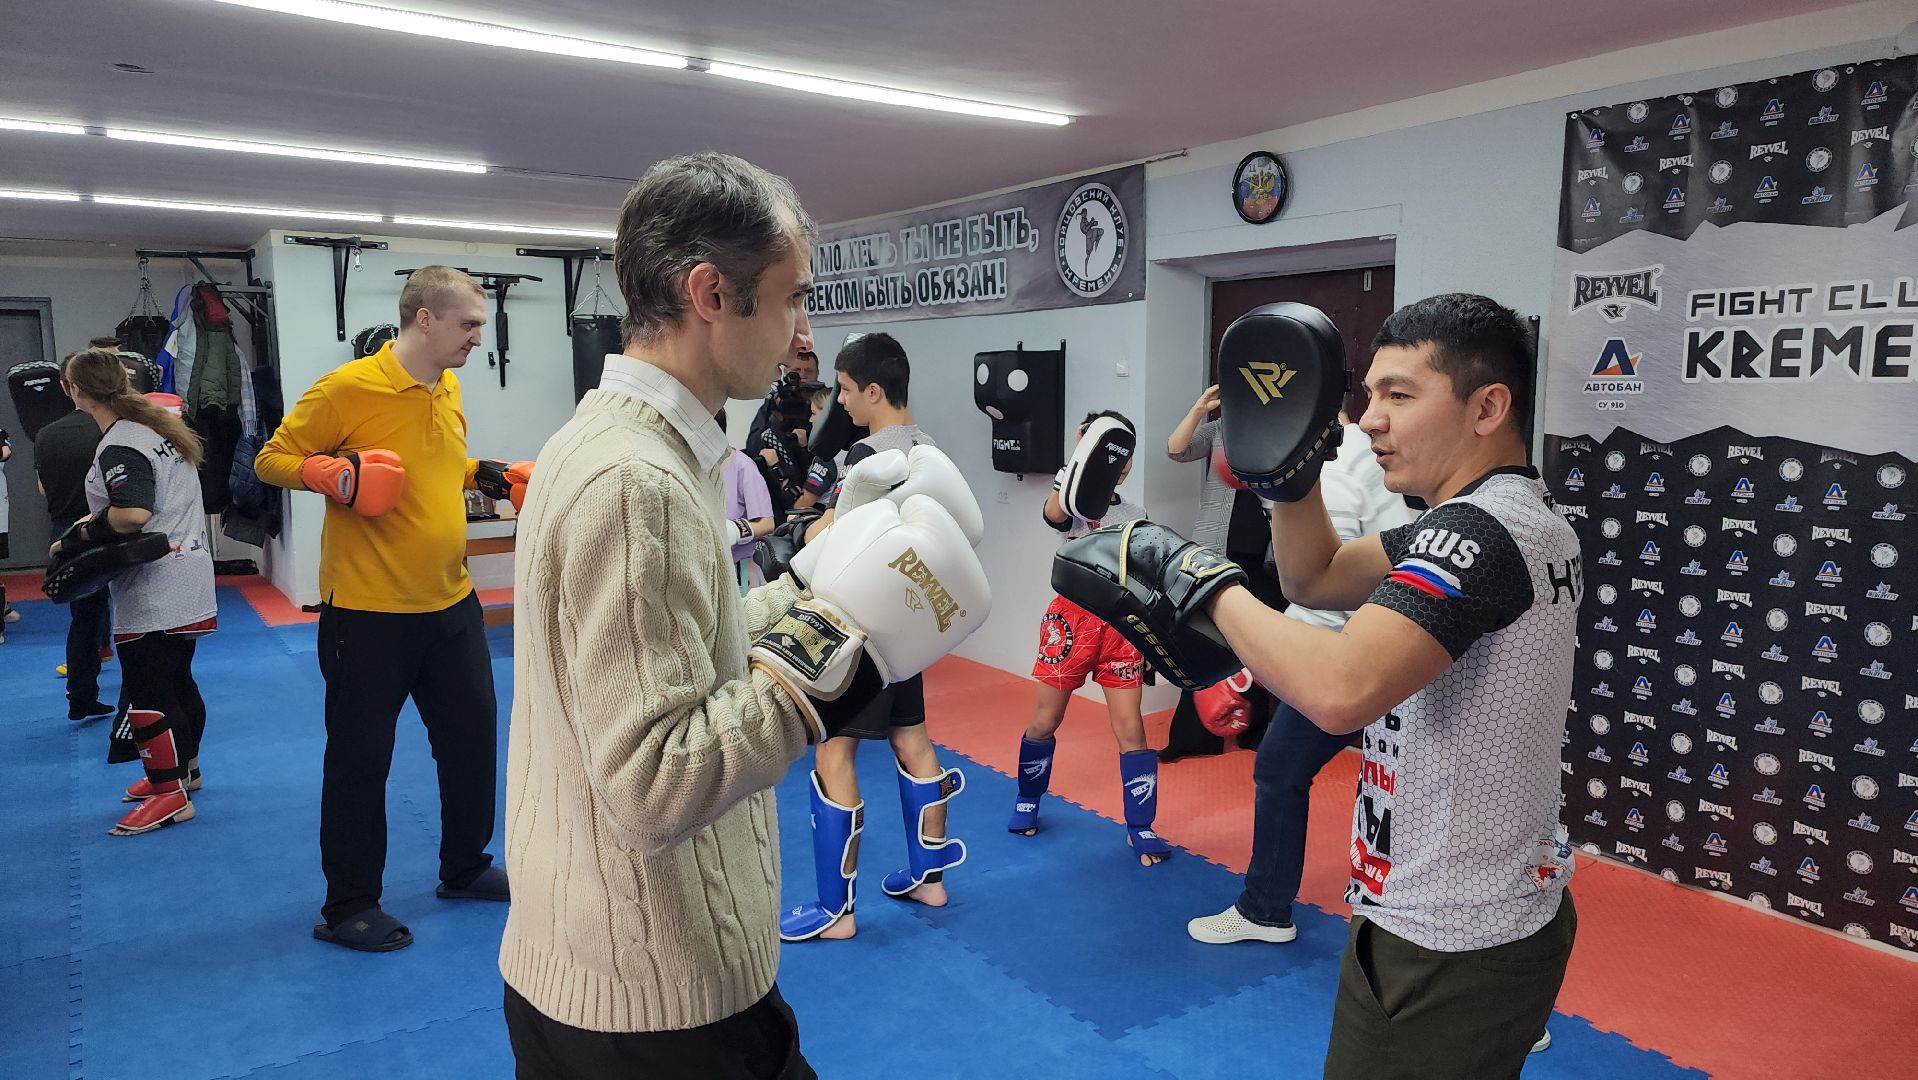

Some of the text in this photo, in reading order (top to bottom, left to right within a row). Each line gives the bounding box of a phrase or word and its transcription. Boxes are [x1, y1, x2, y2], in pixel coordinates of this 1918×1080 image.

[1850, 126, 1890, 146] REYVEL
[1749, 141, 1788, 160] REYVEL
[1659, 155, 1694, 172] REYVEL
[1578, 166, 1608, 183] REYVEL
[900, 225, 929, 264] ТЫ
[934, 220, 963, 260] НЕ
[967, 206, 1039, 256] БЫТЬ,
[805, 258, 1008, 315] ВЕКОМ БЫТЬ ОБЯЗАН!
[1063, 263, 1120, 292] КРЕМЕНЬ
[1572, 269, 1659, 311] REYVEL
[1690, 287, 1813, 318] FIGHT
[1583, 382, 1642, 392] АВТОБАН
[1598, 401, 1625, 409] СУ 910
[1726, 445, 1764, 461] REYVEL
[812, 462, 829, 477] RUS
[1635, 510, 1669, 527] REYVEL
[1722, 517, 1758, 535] REYVEL
[1811, 525, 1852, 543] REYVEL
[1409, 528, 1481, 569] RUS
[888, 546, 961, 633] REYVEL
[1631, 577, 1665, 595] REYVEL
[1717, 589, 1752, 607] REYVEL
[1804, 602, 1848, 621] REYVEL
[1627, 644, 1661, 663] REYVEL
[1711, 659, 1746, 680] REYVEL
[1801, 675, 1843, 696] REYVEL
[1624, 710, 1657, 730] REYVEL
[1706, 729, 1739, 751] REYVEL
[1798, 748, 1835, 772] REYVEL
[1620, 775, 1652, 797] REYVEL
[1698, 799, 1734, 820] REYVEL
[1793, 821, 1830, 845] REYVEL
[1615, 841, 1648, 863] REYVEL
[1695, 867, 1733, 887] REYVEL
[1787, 892, 1825, 918] REYVEL
